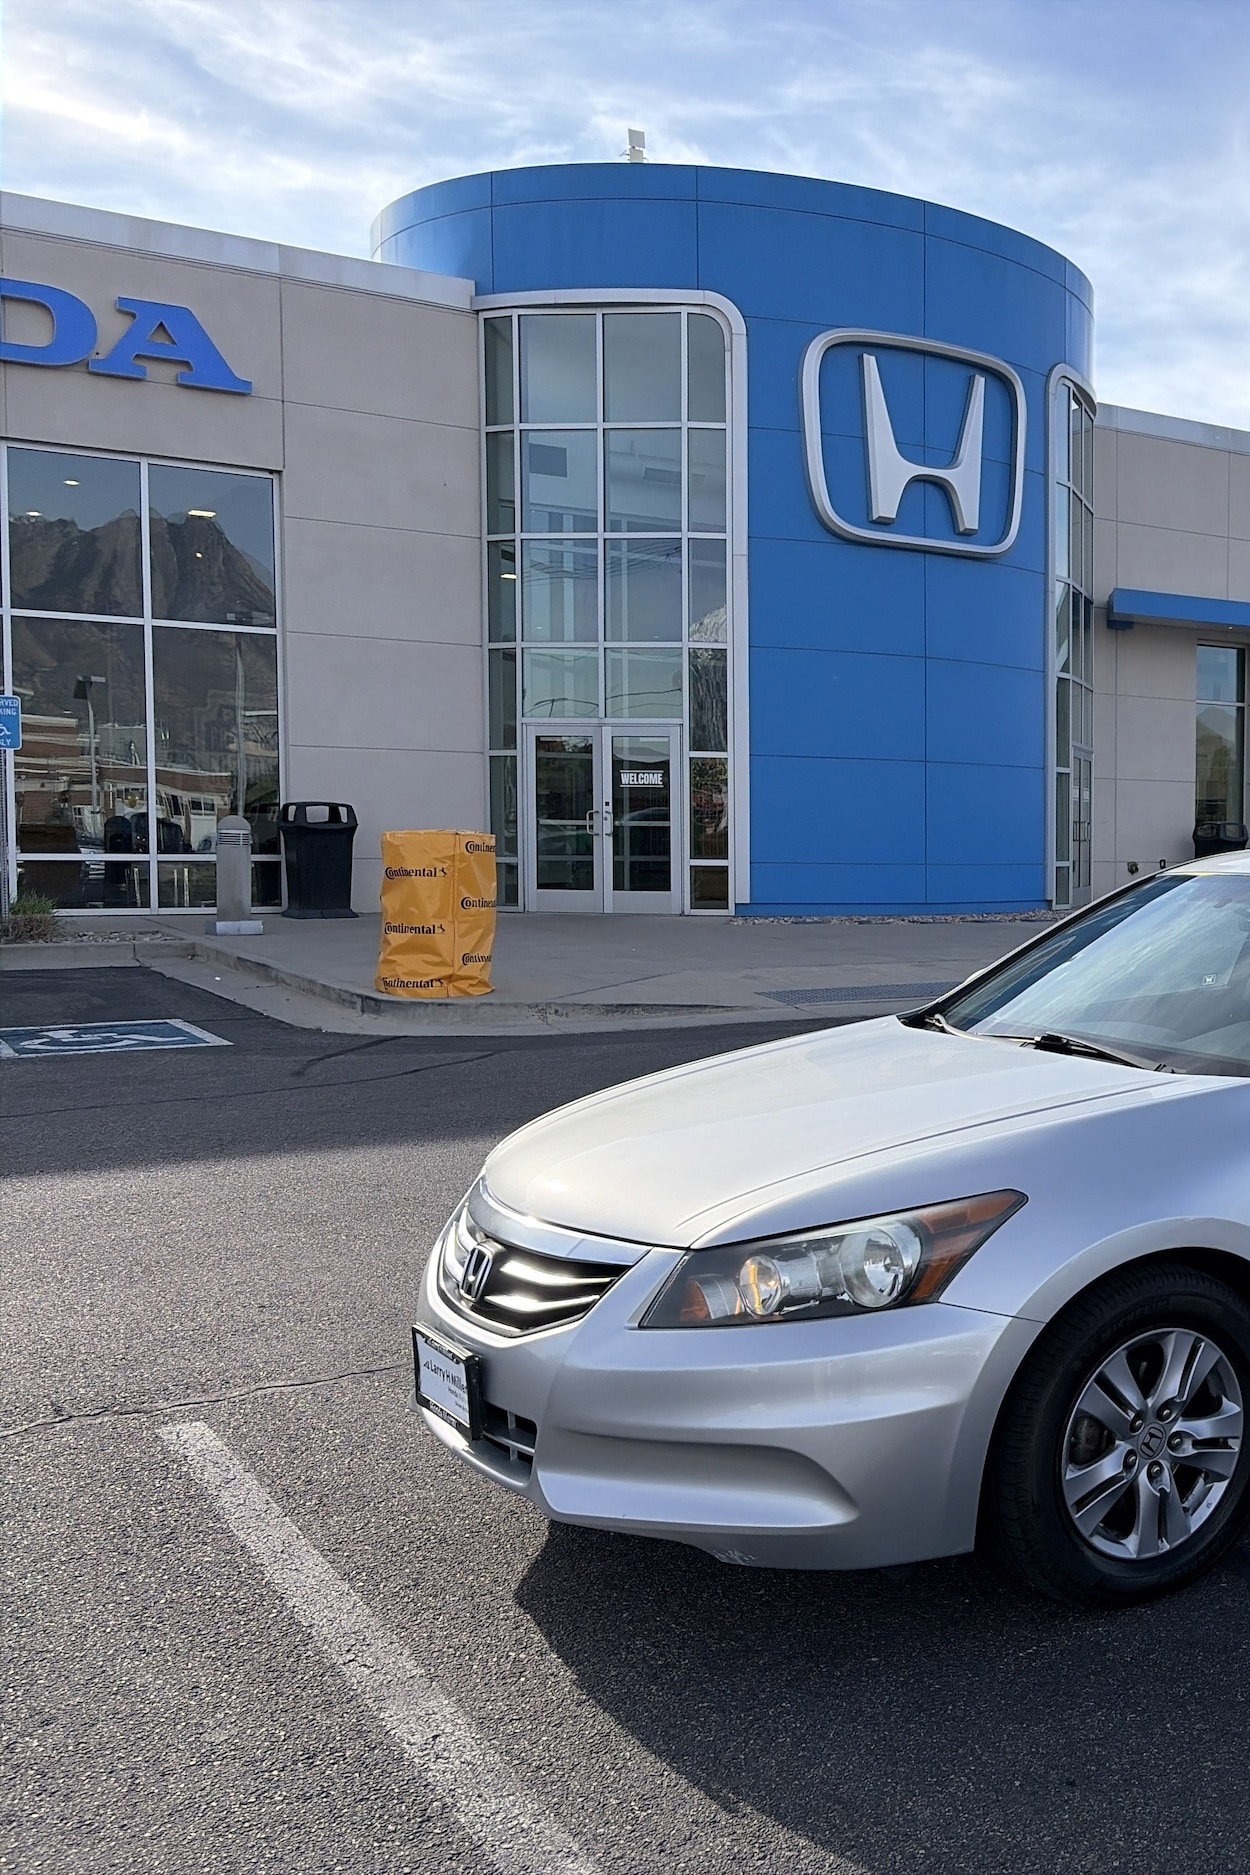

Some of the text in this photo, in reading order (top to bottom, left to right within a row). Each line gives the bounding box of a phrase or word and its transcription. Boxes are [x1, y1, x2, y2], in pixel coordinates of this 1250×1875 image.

[621, 772, 663, 785] WELCOME
[385, 866, 437, 880] Continental
[384, 922, 436, 935] Continental
